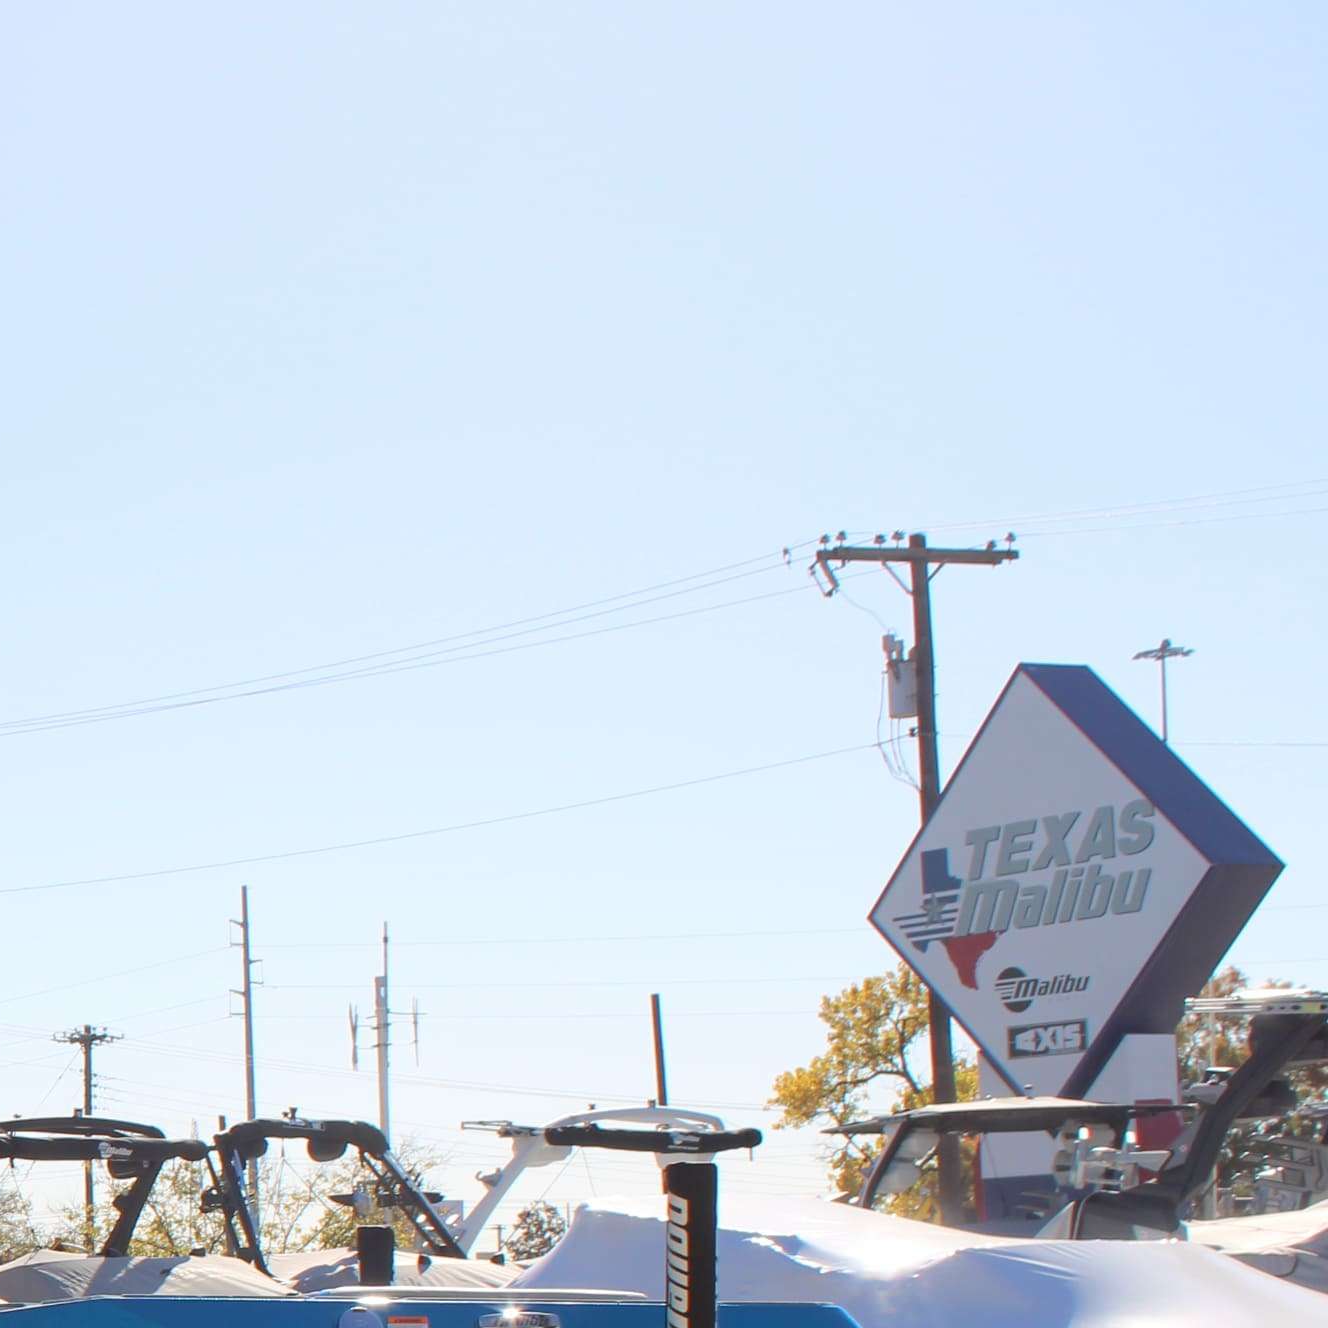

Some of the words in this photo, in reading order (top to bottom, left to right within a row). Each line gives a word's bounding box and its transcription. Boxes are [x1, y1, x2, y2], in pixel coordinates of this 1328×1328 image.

[964, 801, 1156, 881] TEXAS
[954, 863, 1152, 937] Malibu
[1014, 972, 1090, 1000] Malibu
